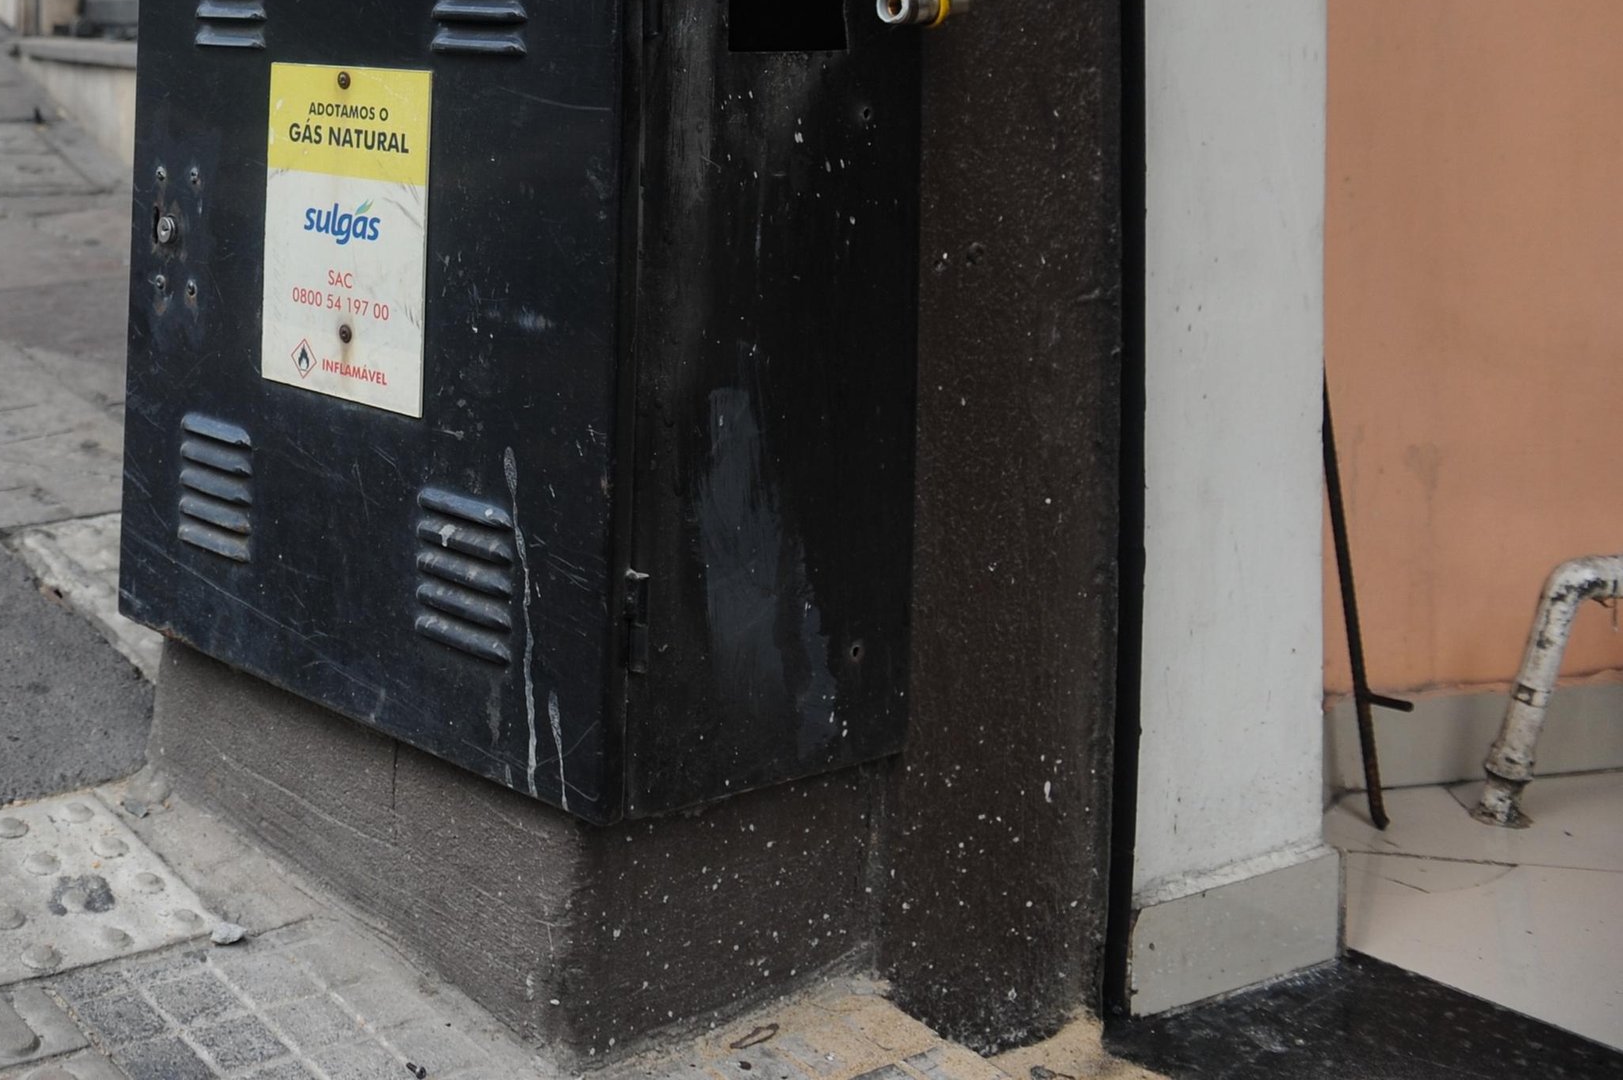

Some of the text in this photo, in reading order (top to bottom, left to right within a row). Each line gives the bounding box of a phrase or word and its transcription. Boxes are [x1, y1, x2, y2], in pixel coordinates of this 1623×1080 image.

[308, 101, 389, 122] ADOTAMOS O
[288, 119, 409, 154] GÁS NATURAL
[303, 199, 381, 245] sulgás
[328, 270, 353, 290] SAC
[292, 287, 390, 321] 0800 54 197 00
[321, 358, 388, 387] INFLAMÁVEL
